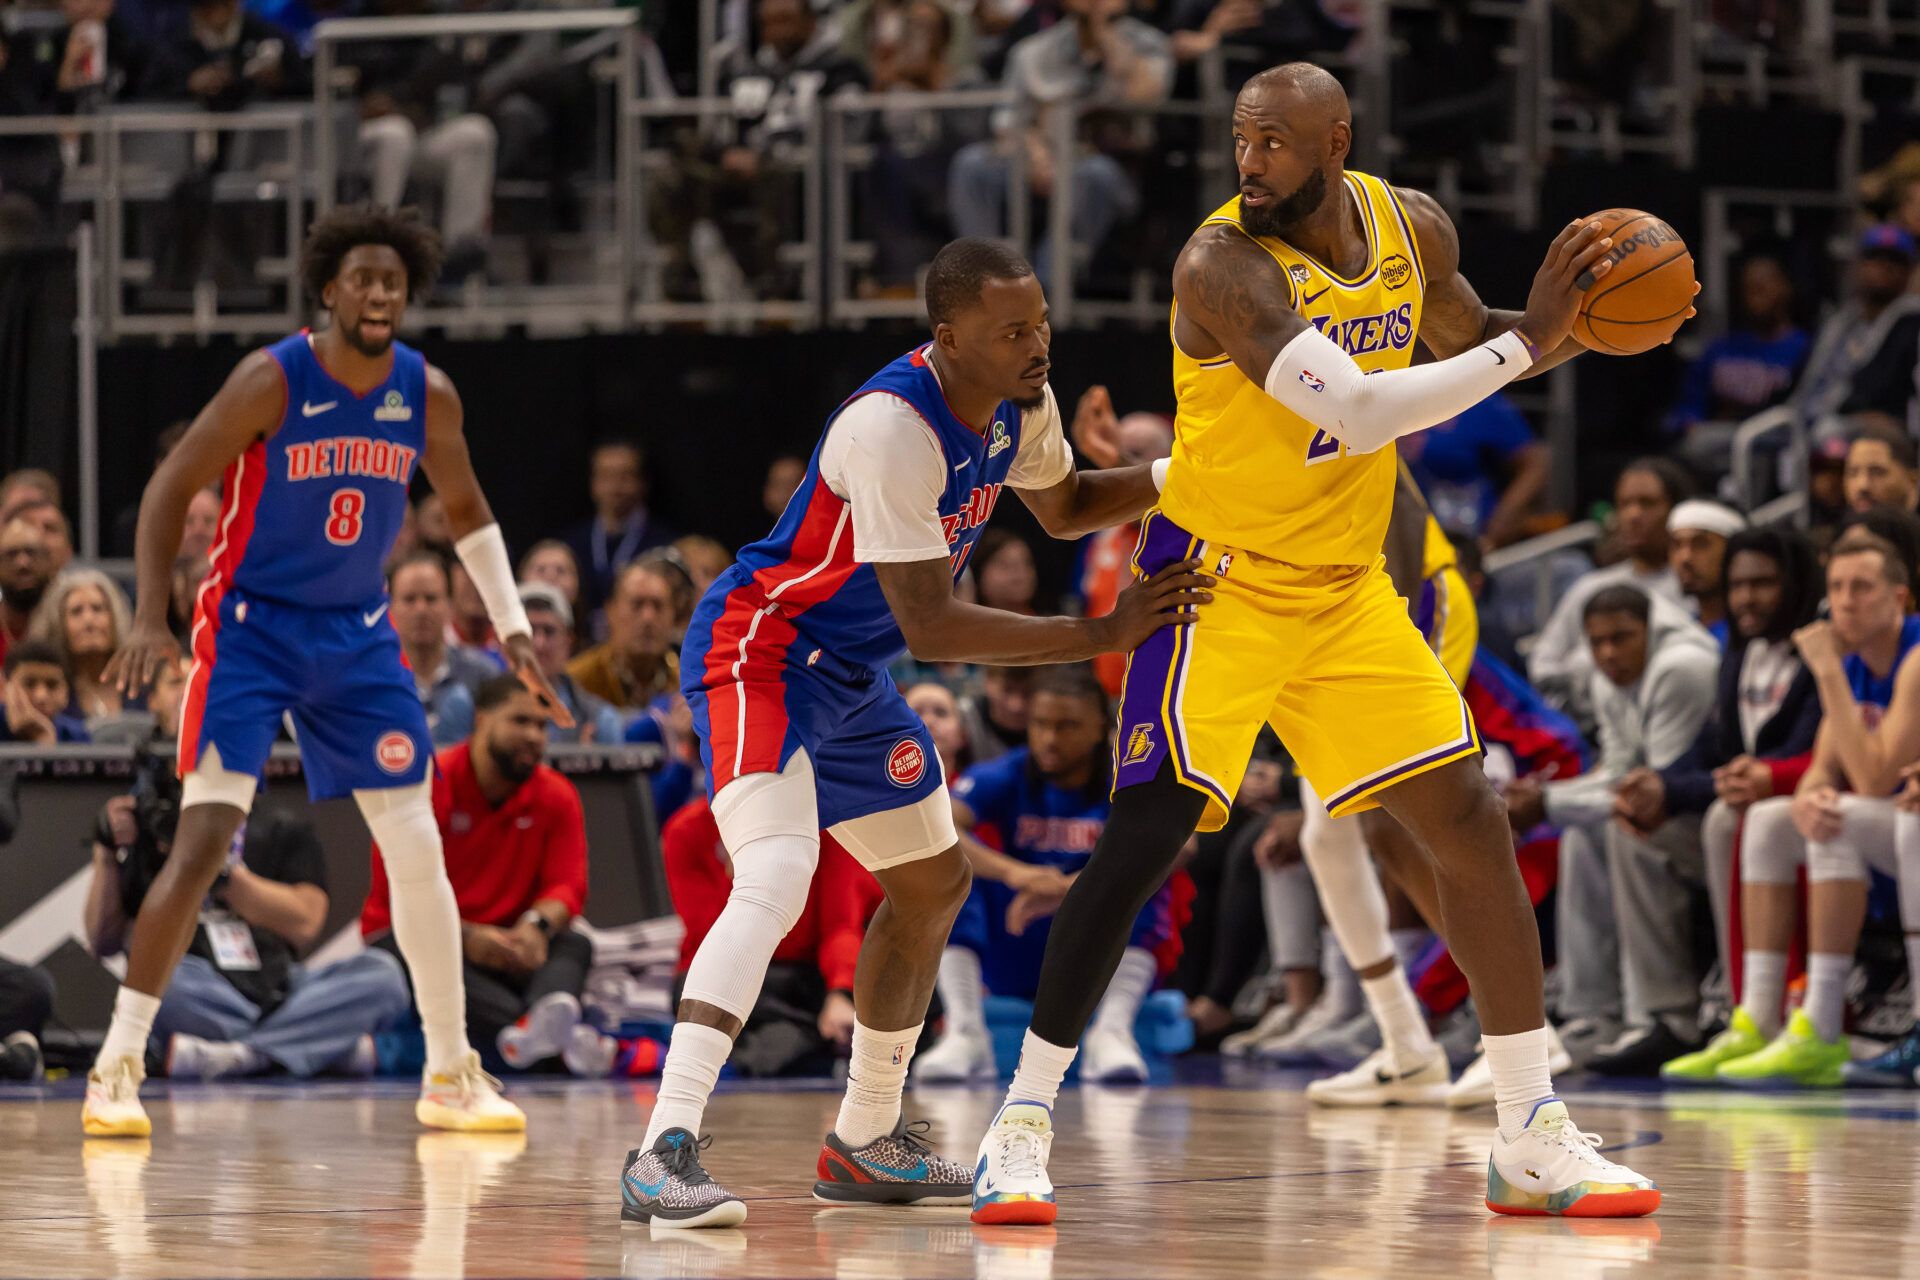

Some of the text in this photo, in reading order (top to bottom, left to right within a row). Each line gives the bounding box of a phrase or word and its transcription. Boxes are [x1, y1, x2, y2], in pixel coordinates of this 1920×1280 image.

[1381, 262, 1409, 281] bibigo
[285, 436, 417, 485] DETROIT
[324, 487, 366, 546] 8
[894, 748, 918, 769] DETROIT
[896, 756, 921, 776] PISTONS
